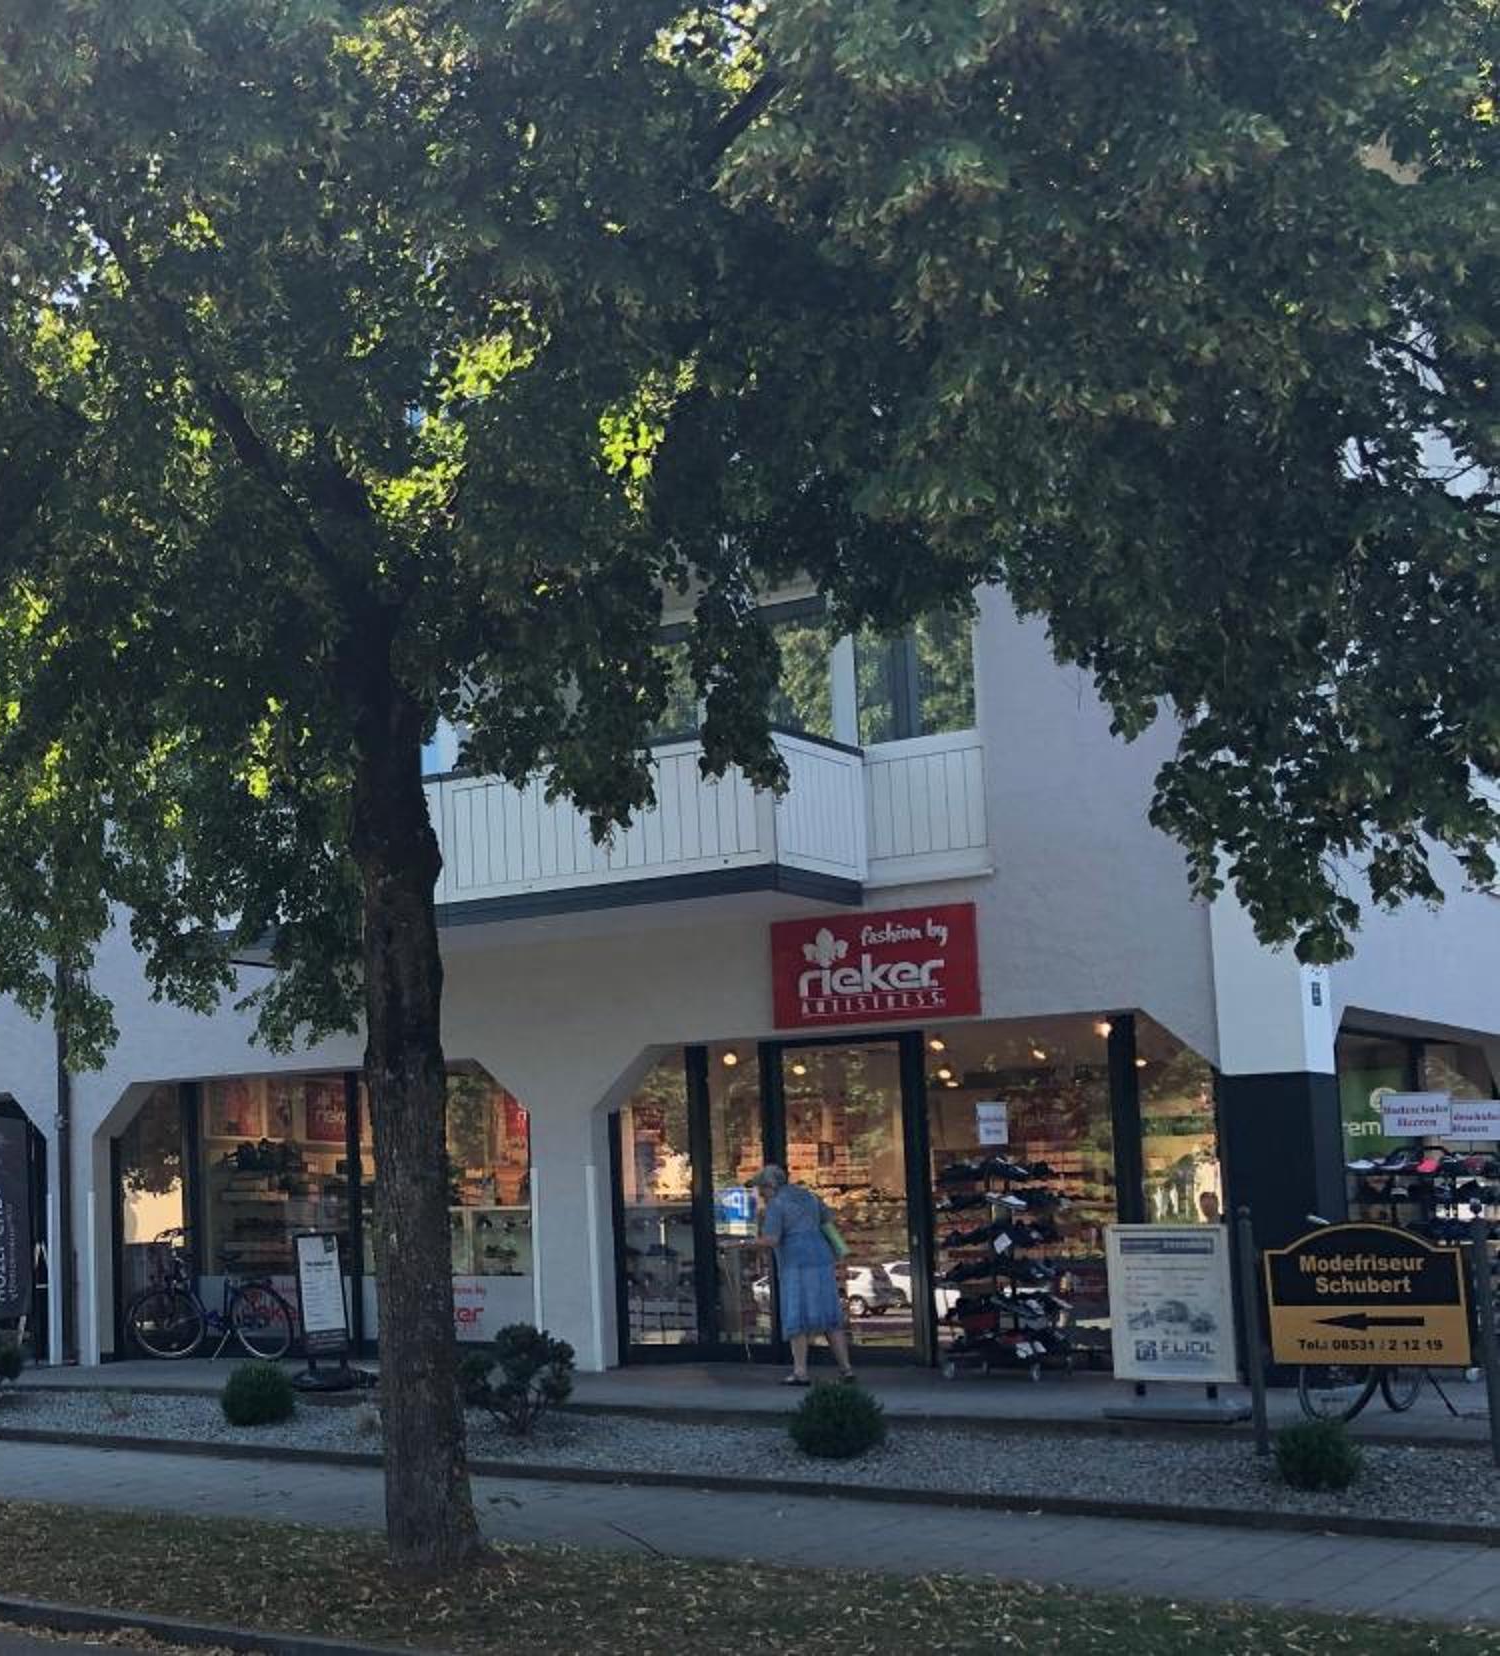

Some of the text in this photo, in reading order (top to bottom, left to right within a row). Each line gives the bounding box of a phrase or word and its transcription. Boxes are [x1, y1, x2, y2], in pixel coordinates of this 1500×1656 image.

[860, 918, 948, 947] fashion by
[799, 953, 945, 998] rieker
[1299, 1254, 1424, 1272] Modefriseur
[1315, 1275, 1413, 1293] Schubert
